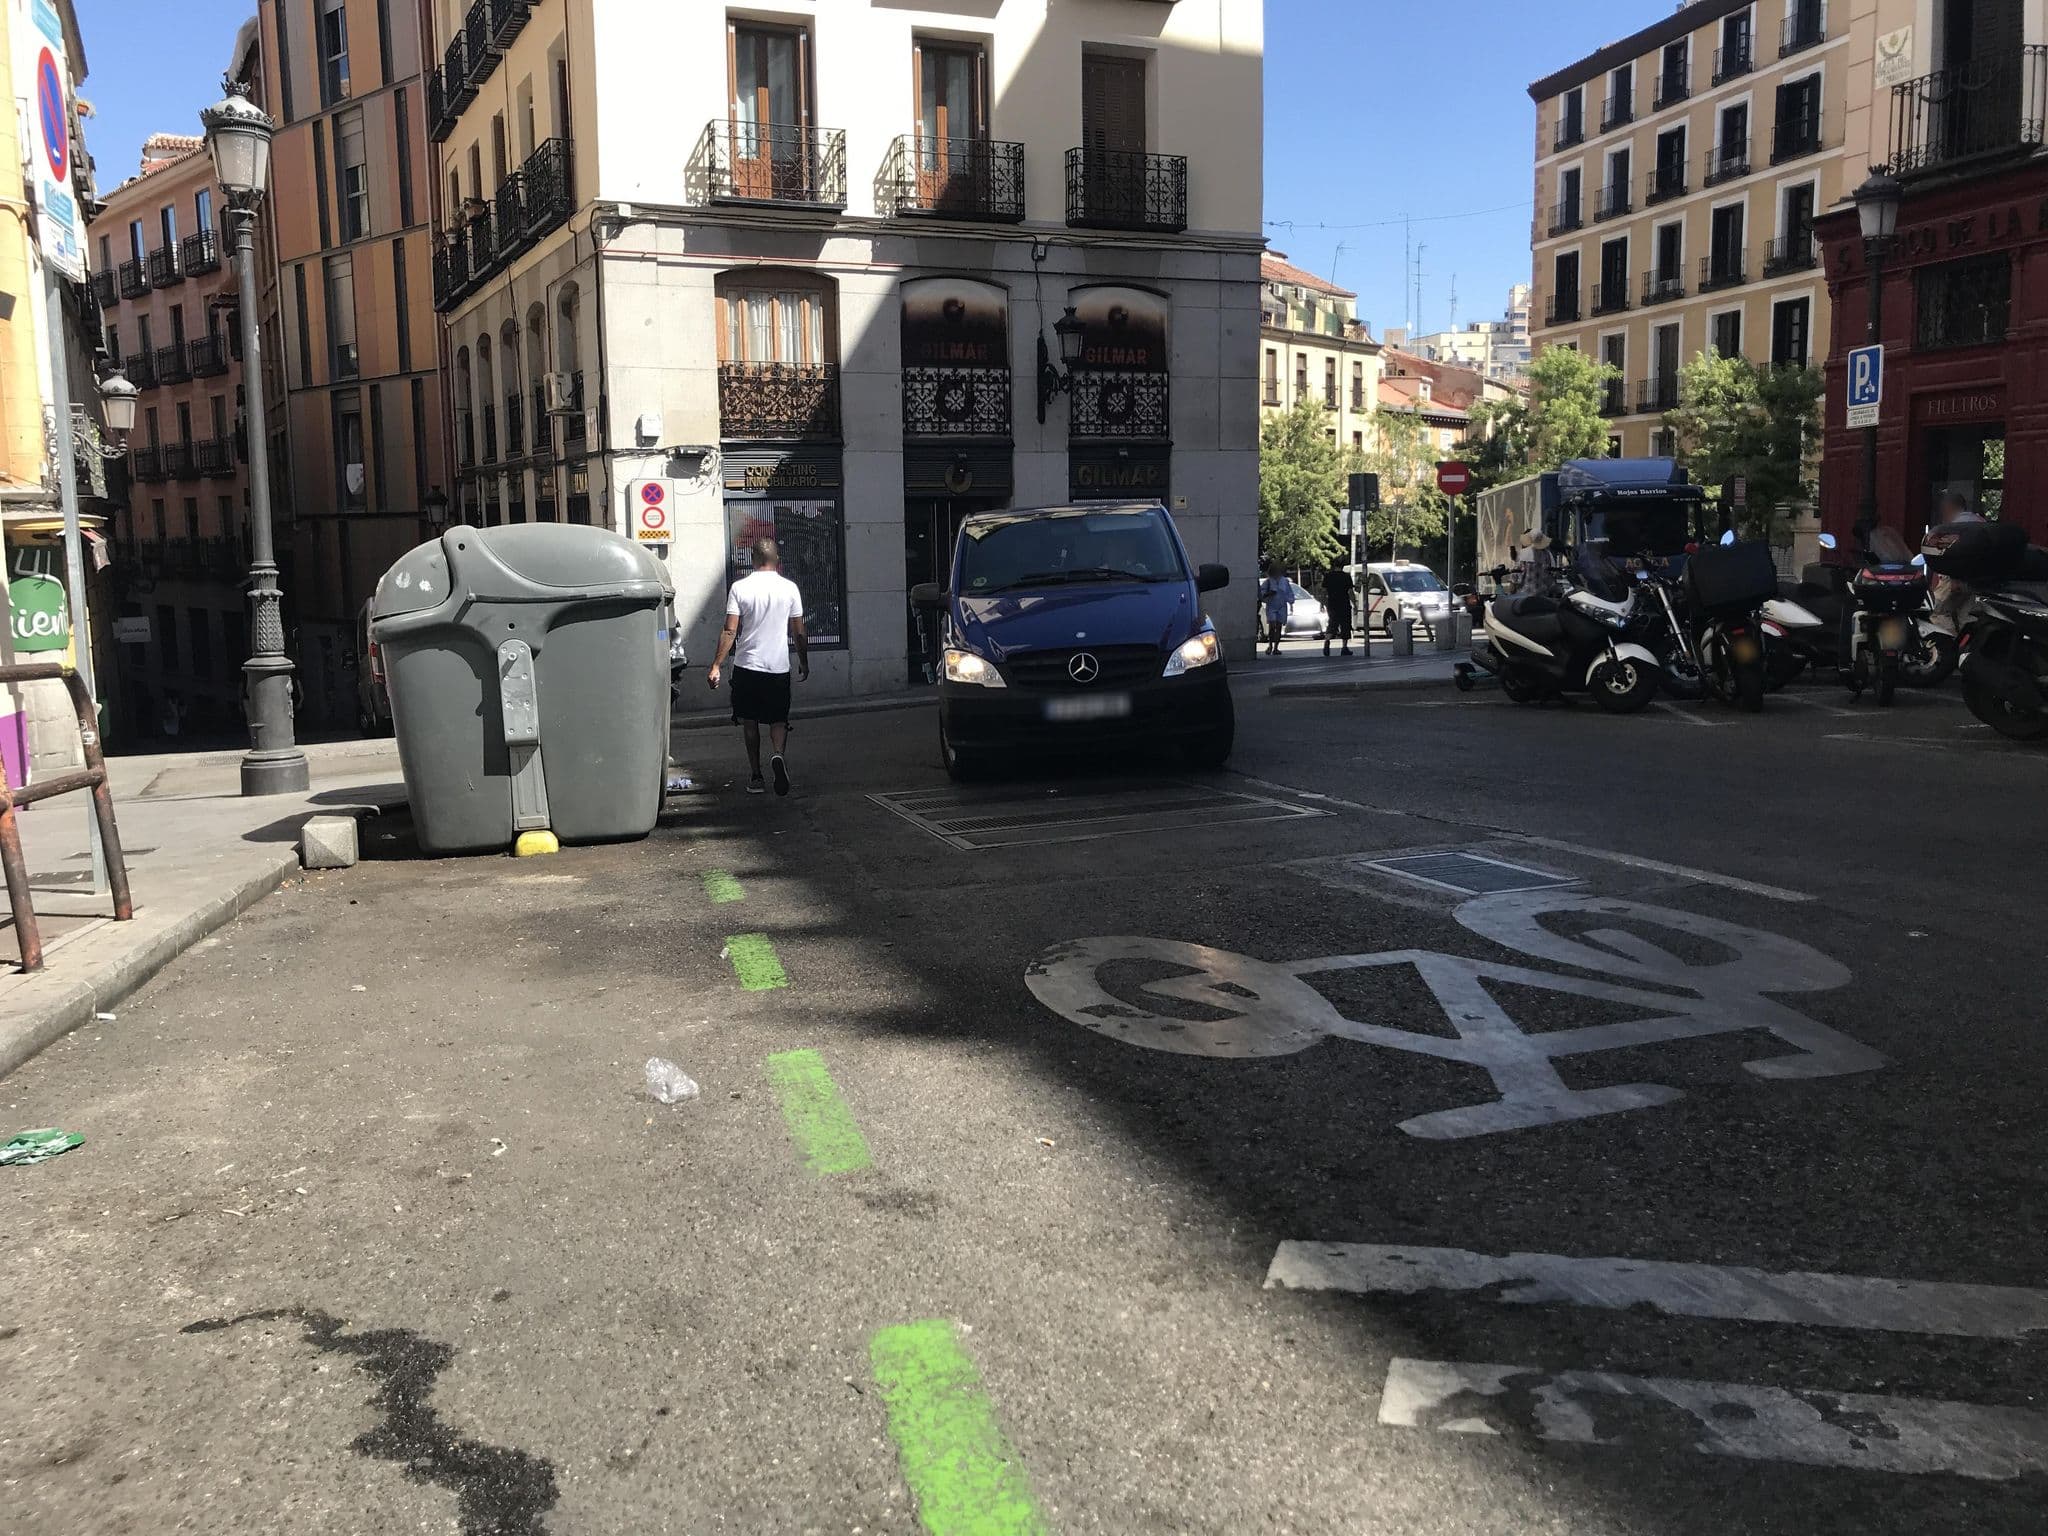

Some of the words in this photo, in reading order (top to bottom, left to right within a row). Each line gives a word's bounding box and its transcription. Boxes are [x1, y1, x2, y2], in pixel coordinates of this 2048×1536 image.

[1087, 346, 1147, 365] GILMAR
[746, 464, 817, 476] CONSULTING
[1077, 464, 1160, 487] GILMAR
[746, 476, 818, 487] INMOBILIARIO
